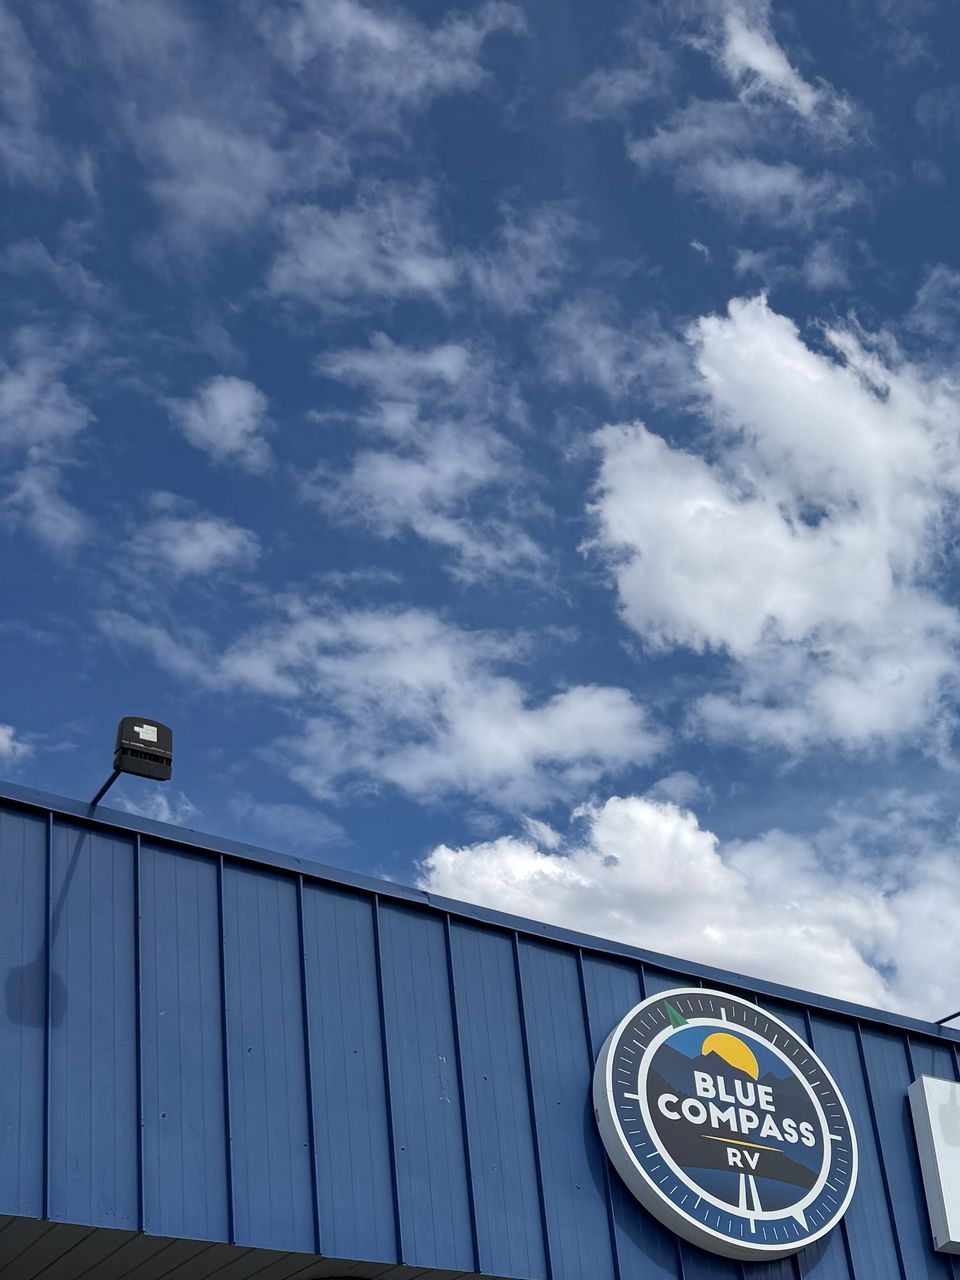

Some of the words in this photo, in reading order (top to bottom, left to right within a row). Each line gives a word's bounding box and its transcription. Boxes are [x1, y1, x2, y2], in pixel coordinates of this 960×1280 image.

[694, 1070, 775, 1112] BLUE
[657, 1093, 816, 1147] COMPASS
[726, 1147, 760, 1170] RV
